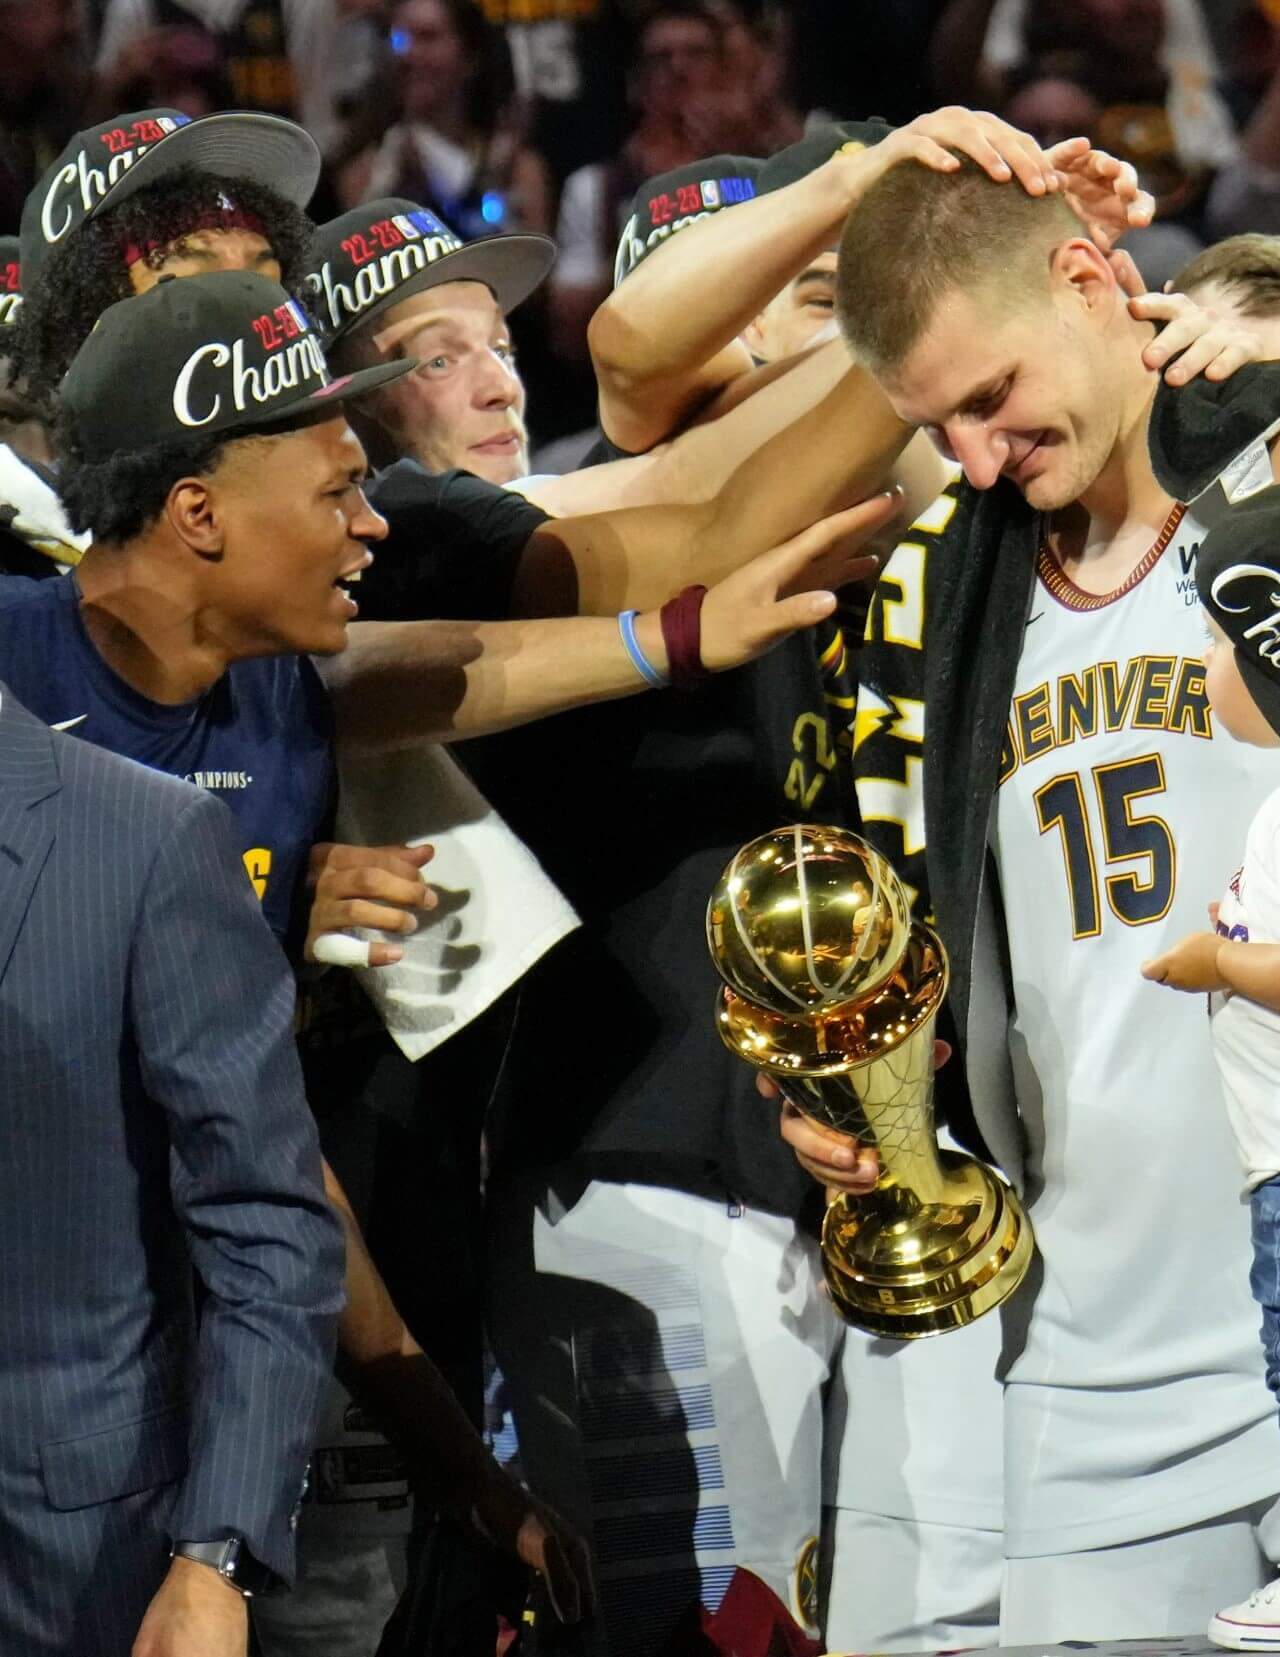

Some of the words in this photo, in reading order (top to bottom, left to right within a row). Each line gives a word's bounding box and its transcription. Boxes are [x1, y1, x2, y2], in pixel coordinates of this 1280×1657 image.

[41, 150, 148, 243] Cha
[649, 184, 702, 225] 22-23
[341, 218, 403, 266] 22-23
[1032, 752, 1177, 942] 15
